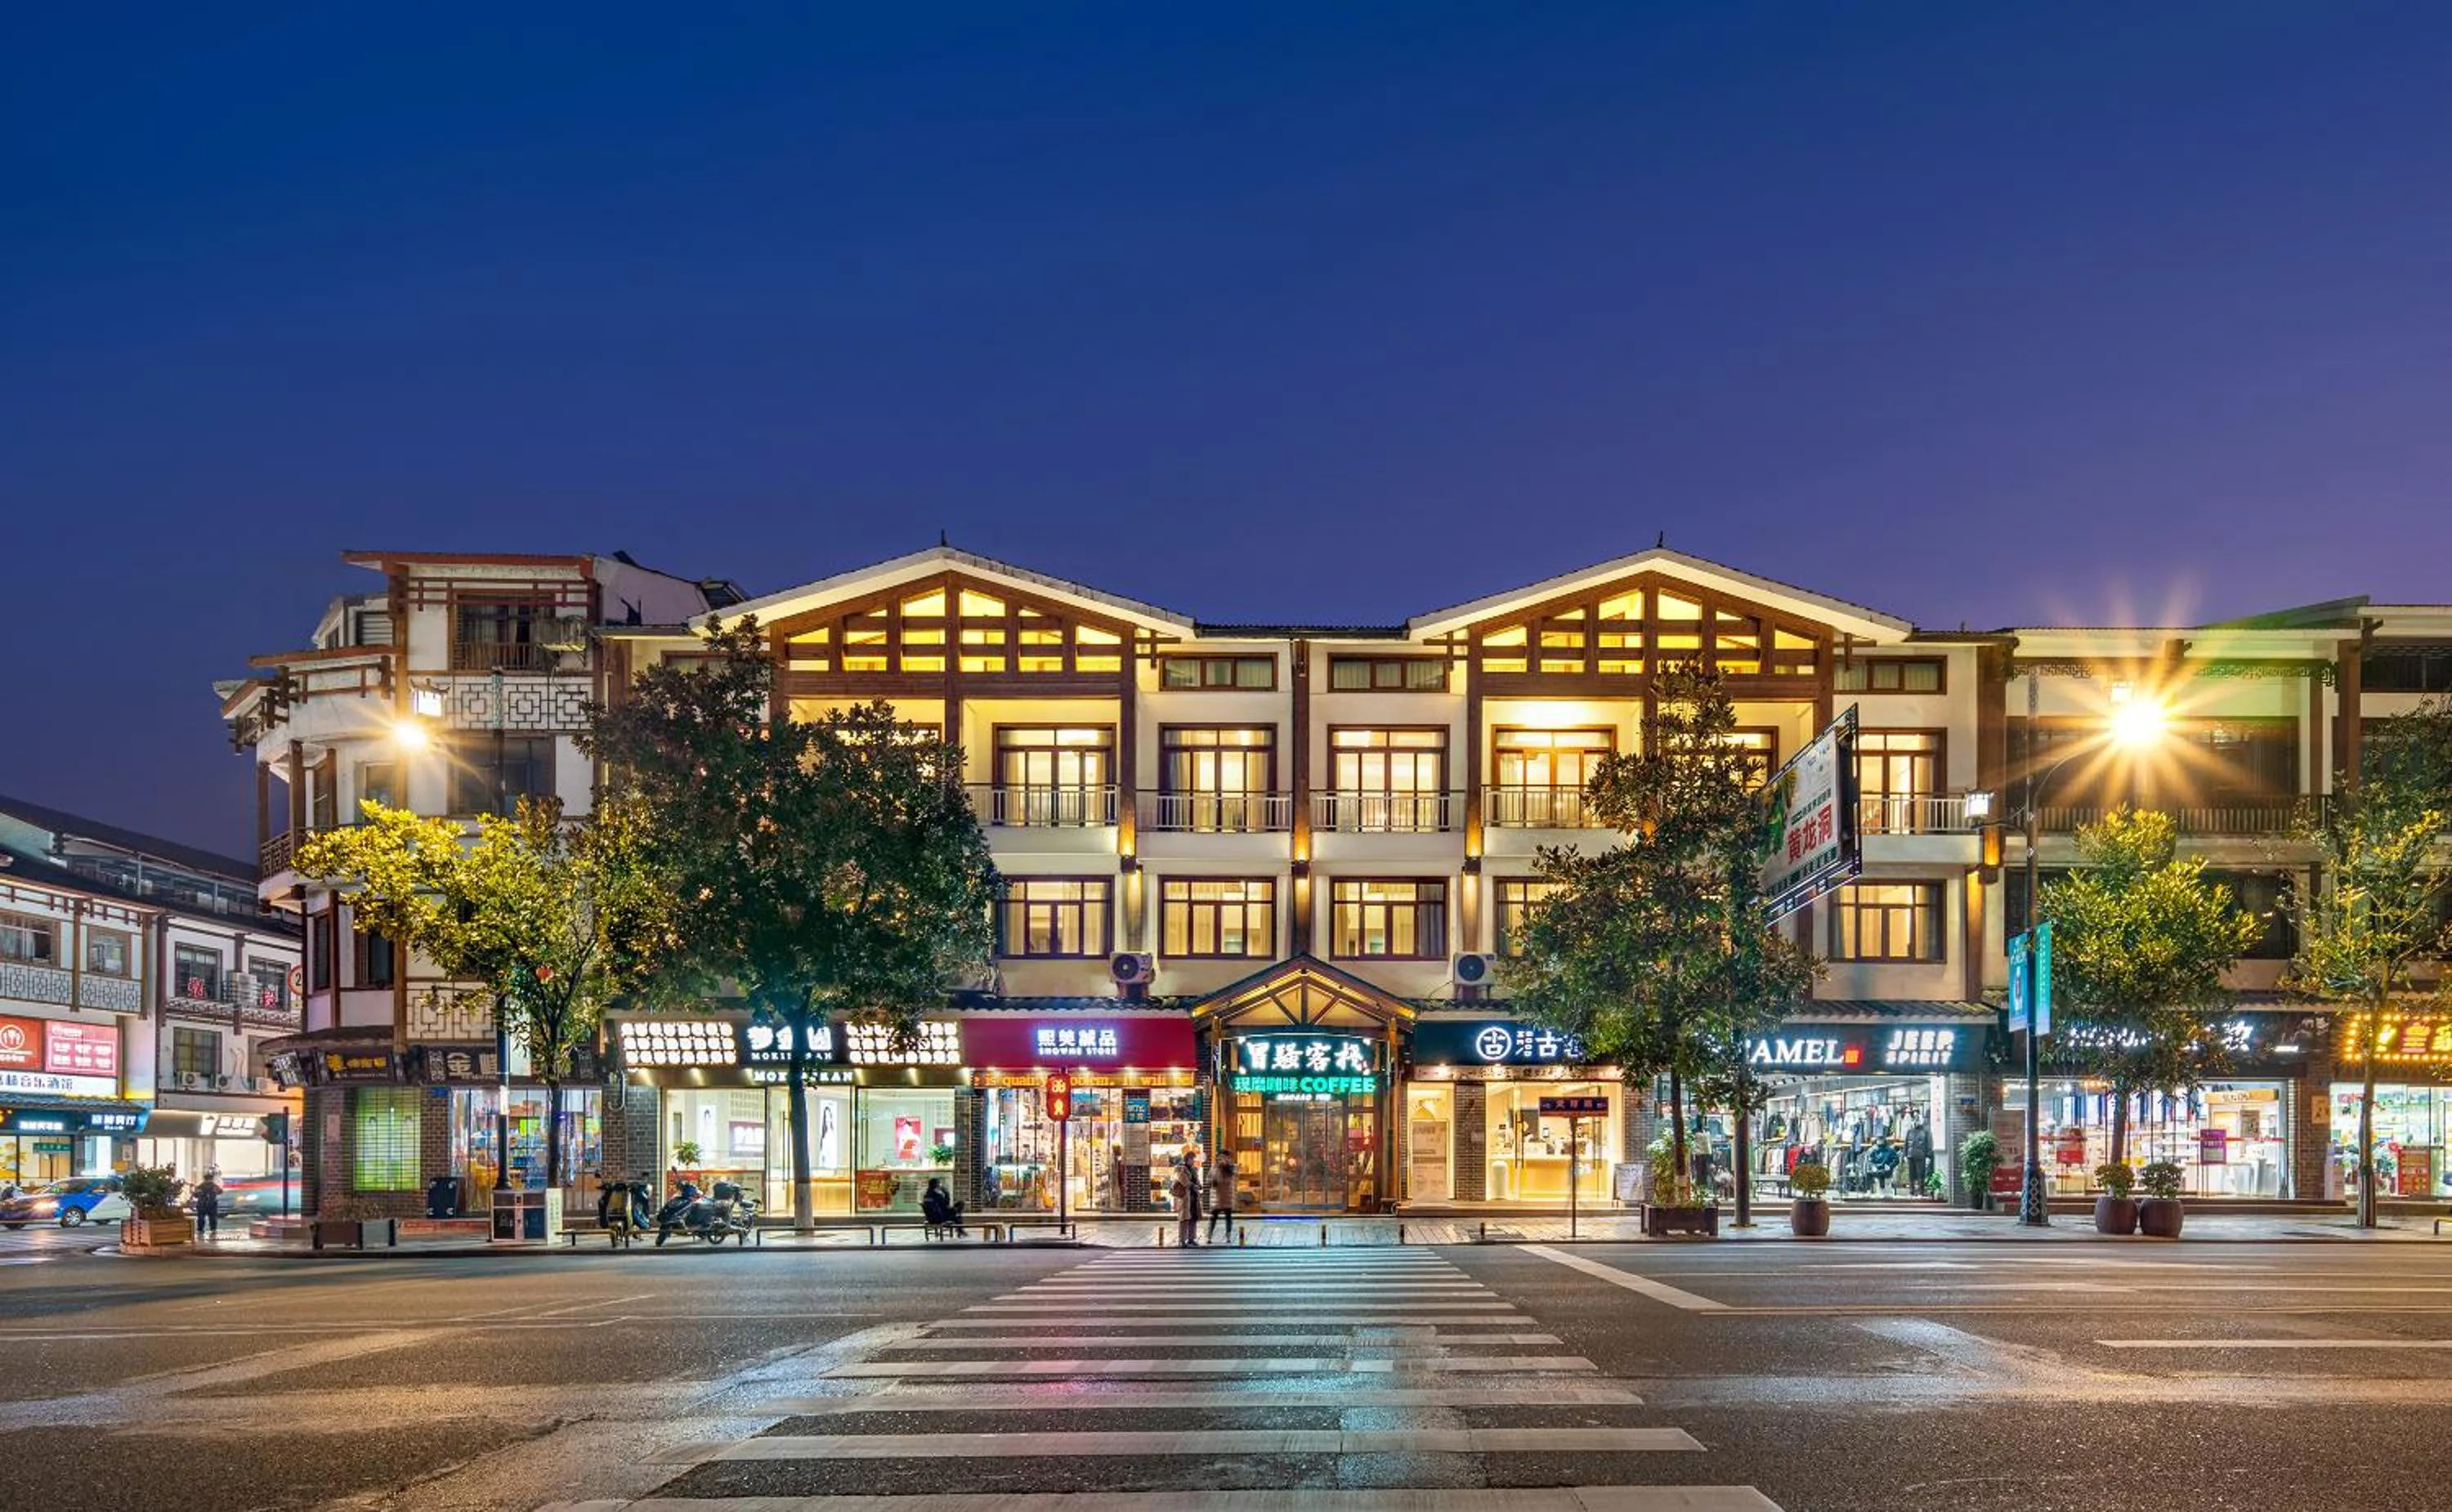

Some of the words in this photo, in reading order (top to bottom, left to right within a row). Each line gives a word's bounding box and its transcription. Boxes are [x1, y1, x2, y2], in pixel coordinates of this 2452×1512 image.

[1788, 803, 1833, 865] 黄龙洞
[1086, 1047, 1117, 1056] STORE
[1746, 1039, 1844, 1063] AMEL
[1886, 1050, 1953, 1064] SPIRIT
[1300, 1076, 1376, 1093] COFFEE
